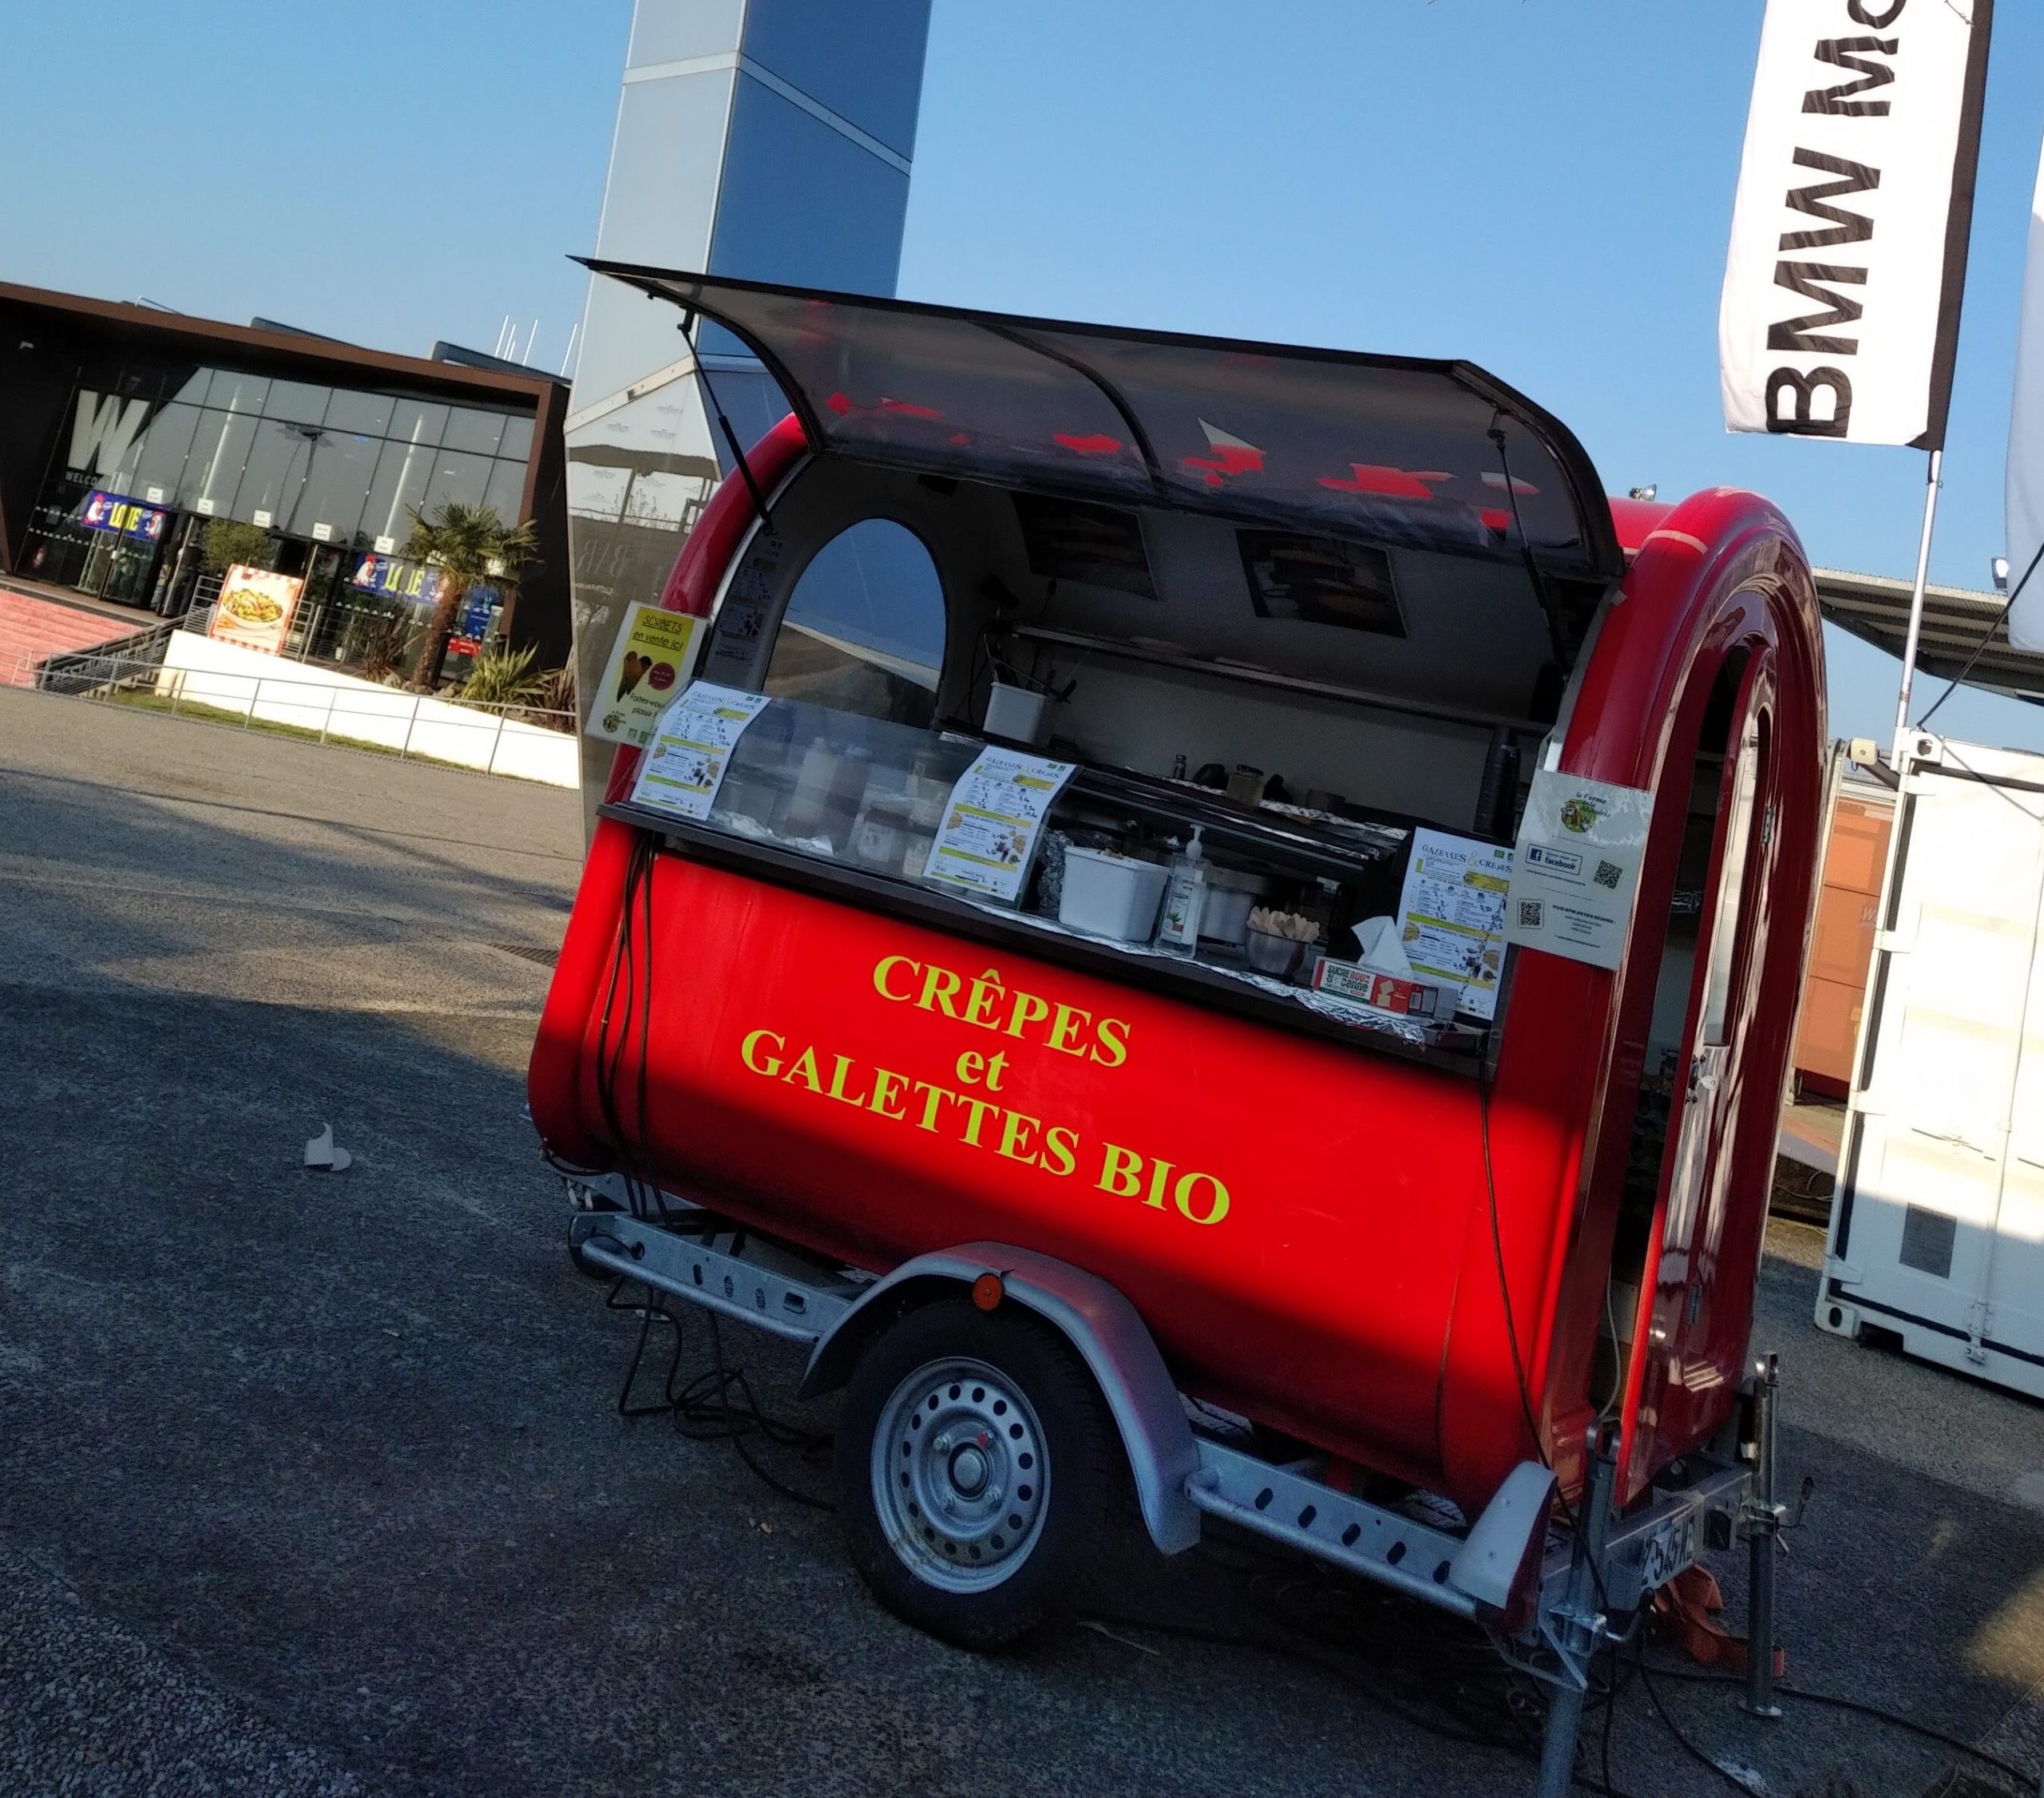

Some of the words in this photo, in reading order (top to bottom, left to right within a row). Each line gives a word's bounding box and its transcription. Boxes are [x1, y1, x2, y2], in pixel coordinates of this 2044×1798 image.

[1765, 146, 1880, 438] BMW
[645, 634, 669, 646] vente
[1545, 856, 1576, 870] facebook
[1328, 965, 1350, 978] SUCRE
[1341, 978, 1369, 992] canne
[873, 955, 1131, 1067] CRÊPES
[956, 1050, 1010, 1091] et
[740, 1029, 1079, 1176] GALETTES
[1094, 1142, 1230, 1225] BIO
